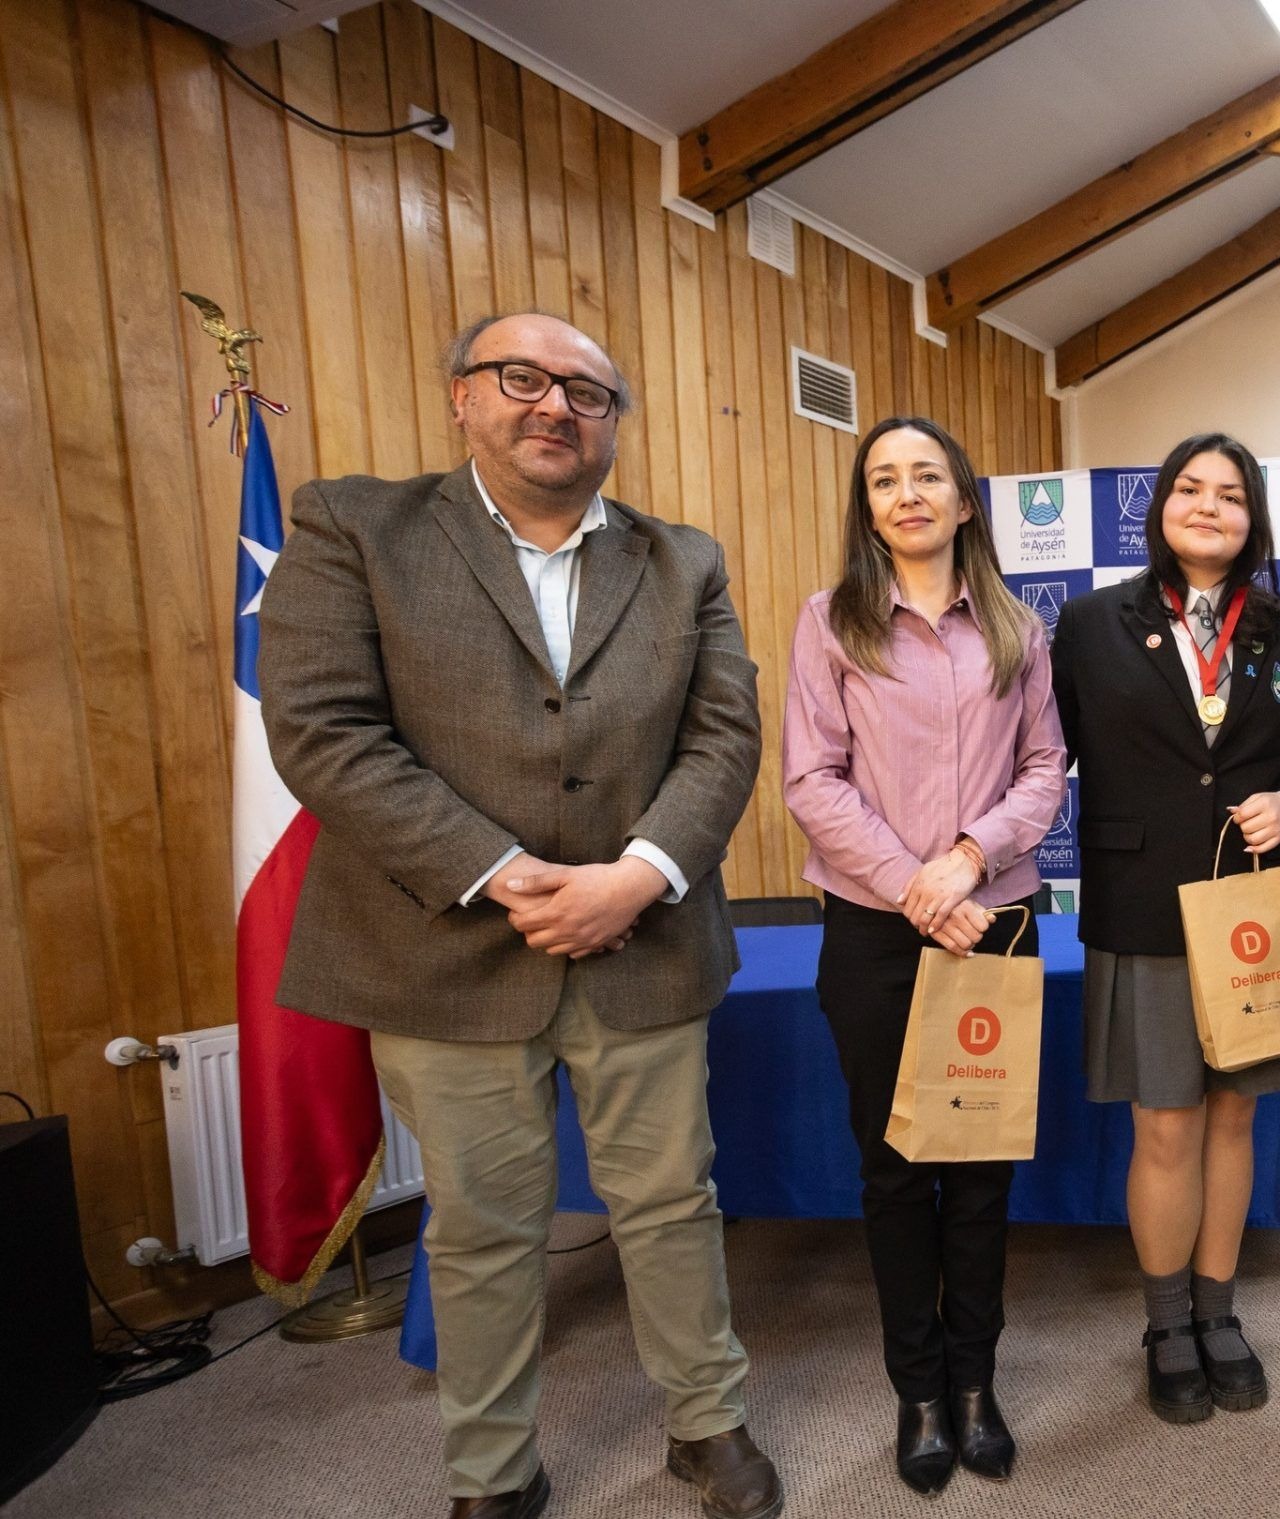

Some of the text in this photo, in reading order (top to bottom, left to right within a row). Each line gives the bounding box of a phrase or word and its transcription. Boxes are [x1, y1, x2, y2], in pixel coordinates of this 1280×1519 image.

[1020, 528, 1065, 539] Universidad
[1119, 524, 1146, 532] Univer
[1021, 537, 1065, 554] de Aysén
[1119, 534, 1129, 542] de
[1040, 837, 1072, 846] versidad
[1038, 847, 1073, 862] Aysén
[1241, 930, 1262, 956] D
[970, 1017, 991, 1045] D
[946, 1064, 1007, 1079] Delibera
